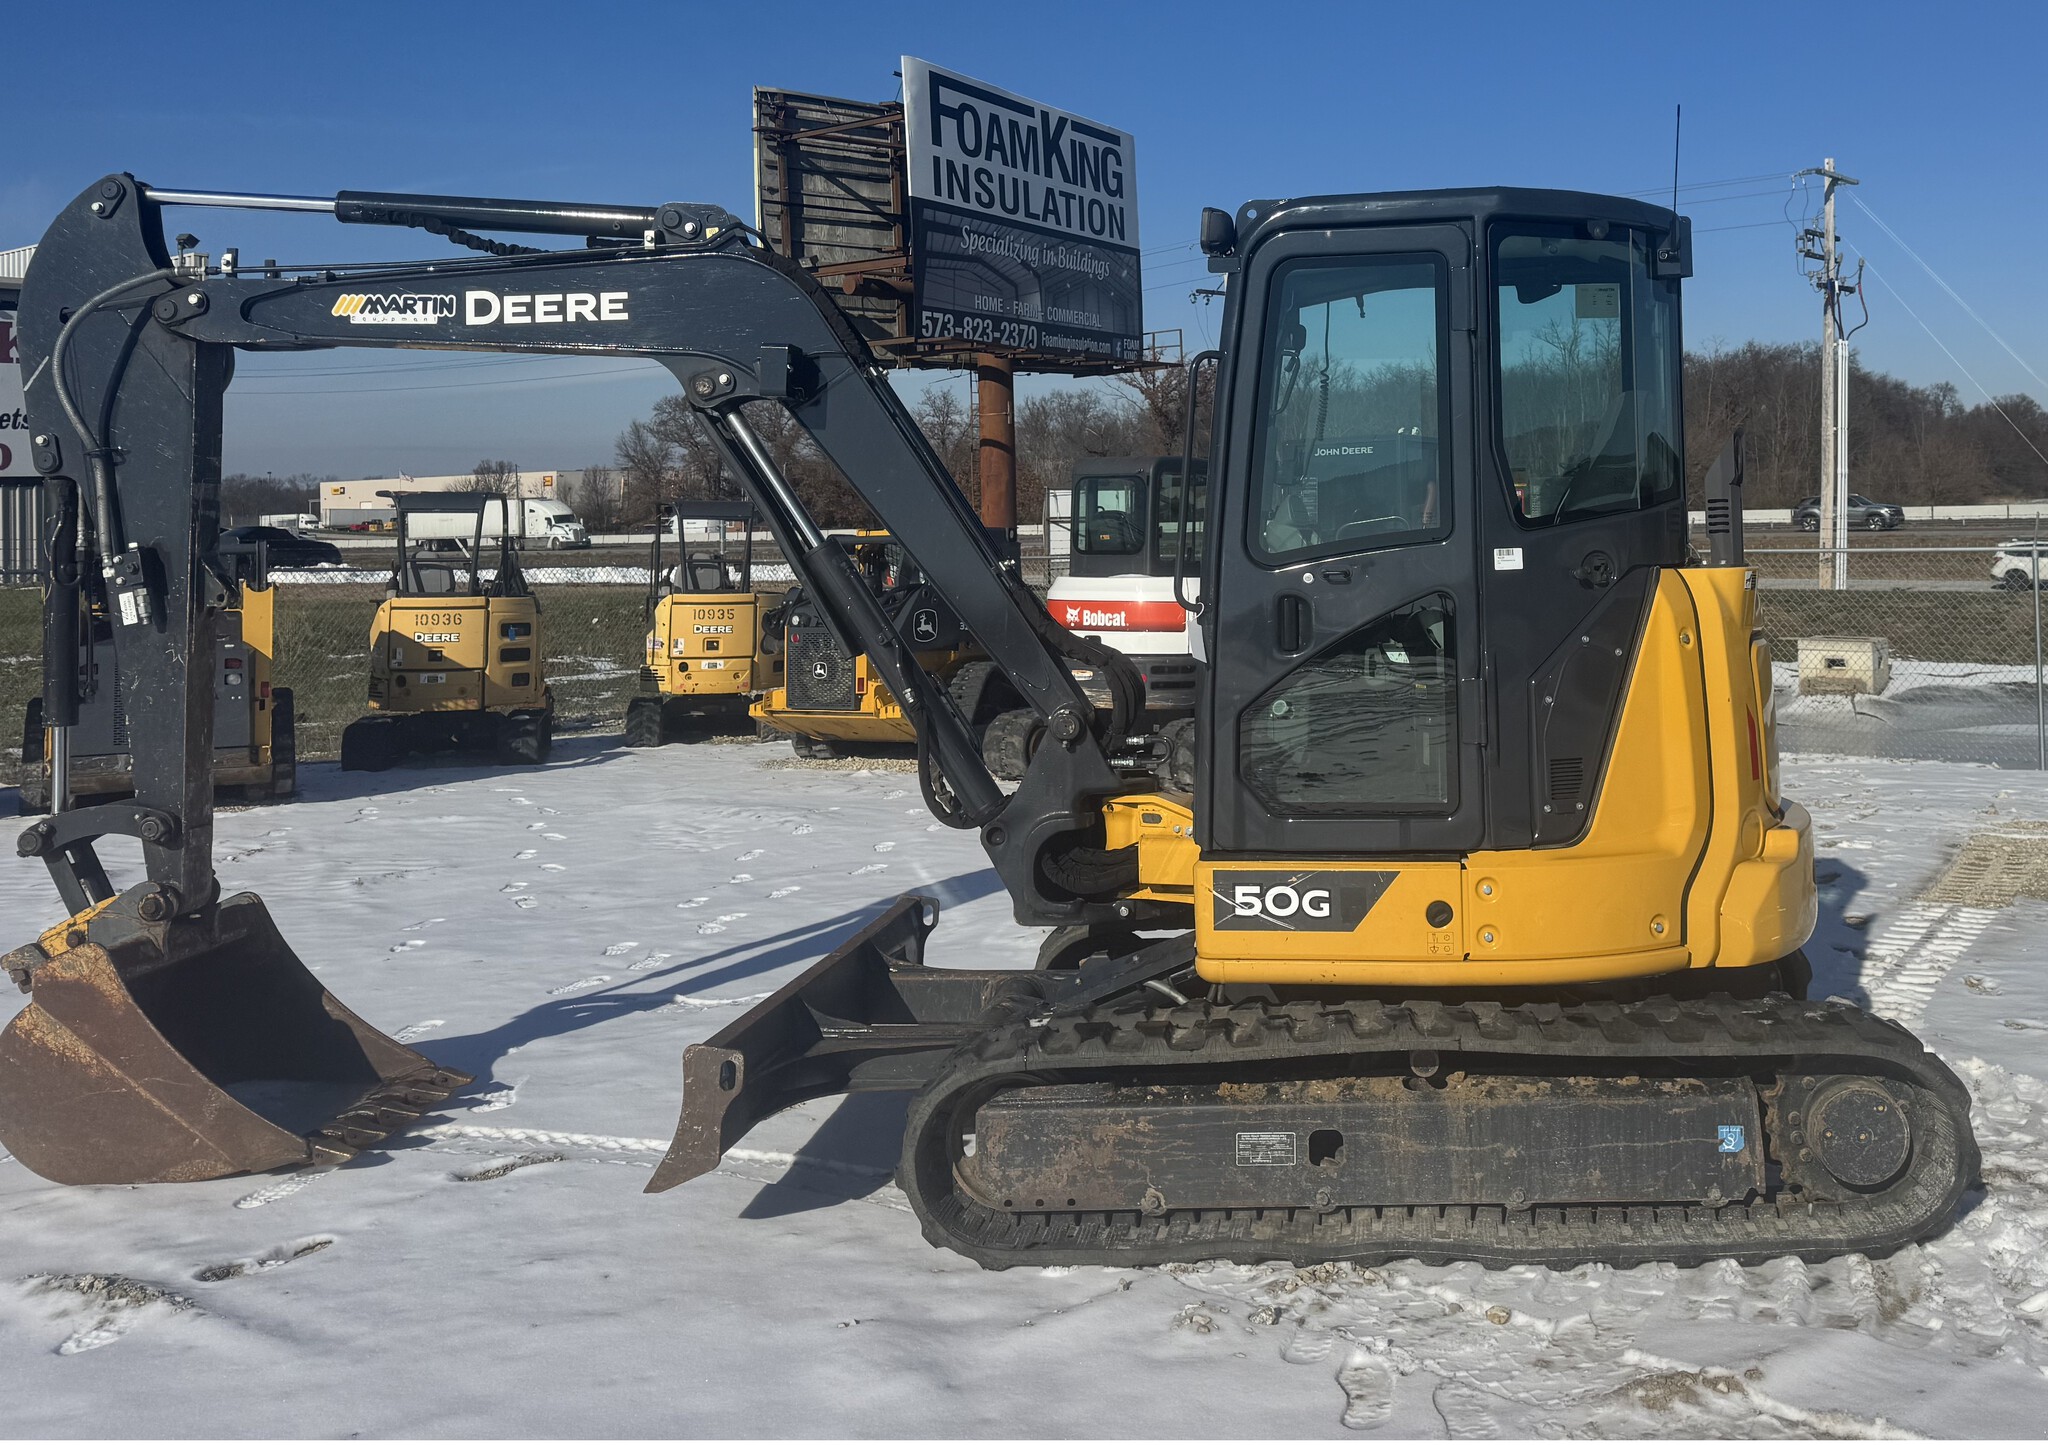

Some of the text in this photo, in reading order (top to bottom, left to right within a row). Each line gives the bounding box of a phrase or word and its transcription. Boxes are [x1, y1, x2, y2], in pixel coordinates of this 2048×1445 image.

[932, 155, 1126, 241] INSULATION
[960, 225, 1110, 280] Specializing in Buildings
[359, 290, 629, 326] MARTIN DEERE
[974, 295, 1004, 313] HOME
[1047, 306, 1102, 327] COMMERCIAL
[1314, 446, 1374, 457] JOHN DEERE
[414, 613, 463, 626] 10936
[693, 608, 735, 620] 10935
[1082, 609, 1127, 627] Bobcat
[414, 632, 461, 643] DEERE
[693, 623, 734, 634] DEERE
[1234, 885, 1331, 918] 50G
